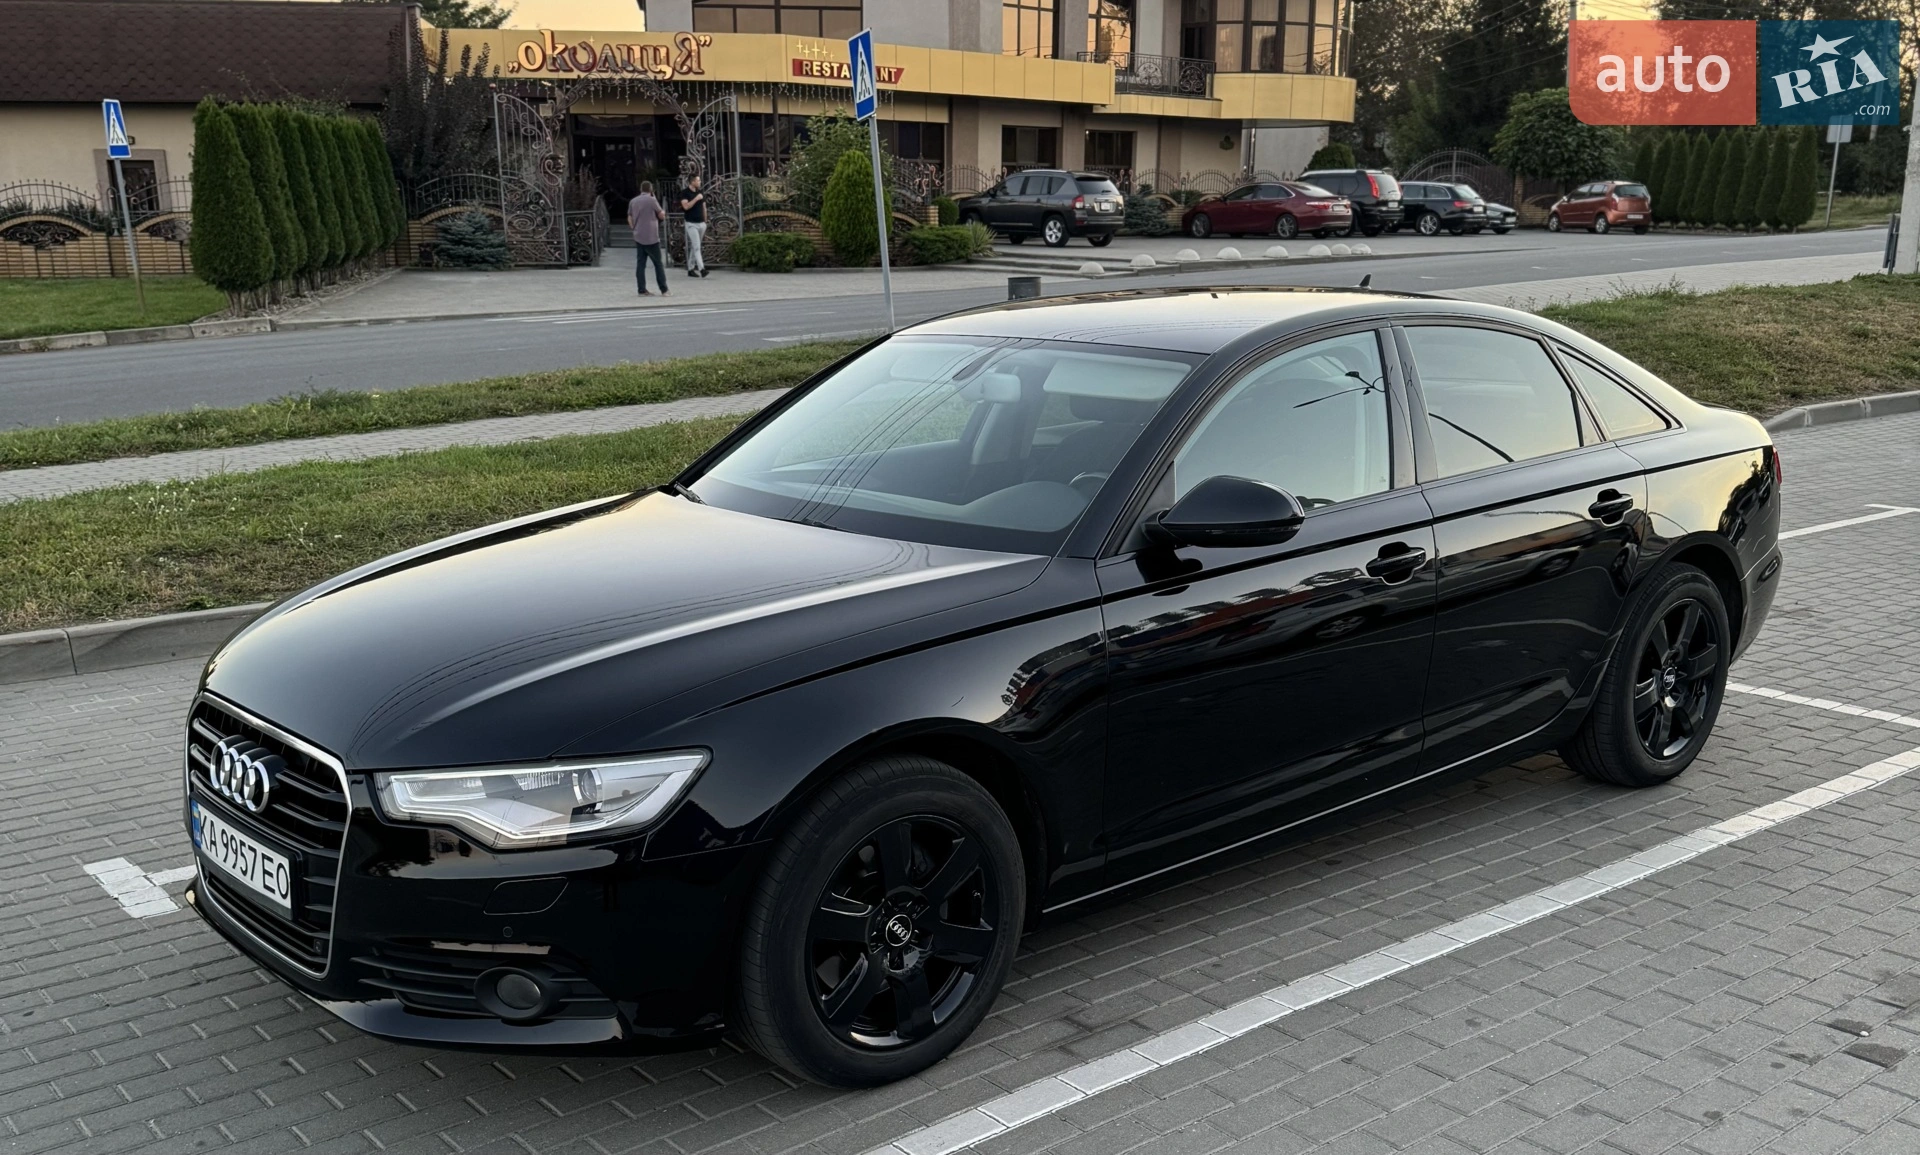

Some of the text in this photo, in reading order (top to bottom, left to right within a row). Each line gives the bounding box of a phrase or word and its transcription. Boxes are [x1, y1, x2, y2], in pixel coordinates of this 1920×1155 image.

[802, 60, 897, 82] RESTANT
[200, 815, 289, 900] KA 9957 EO
